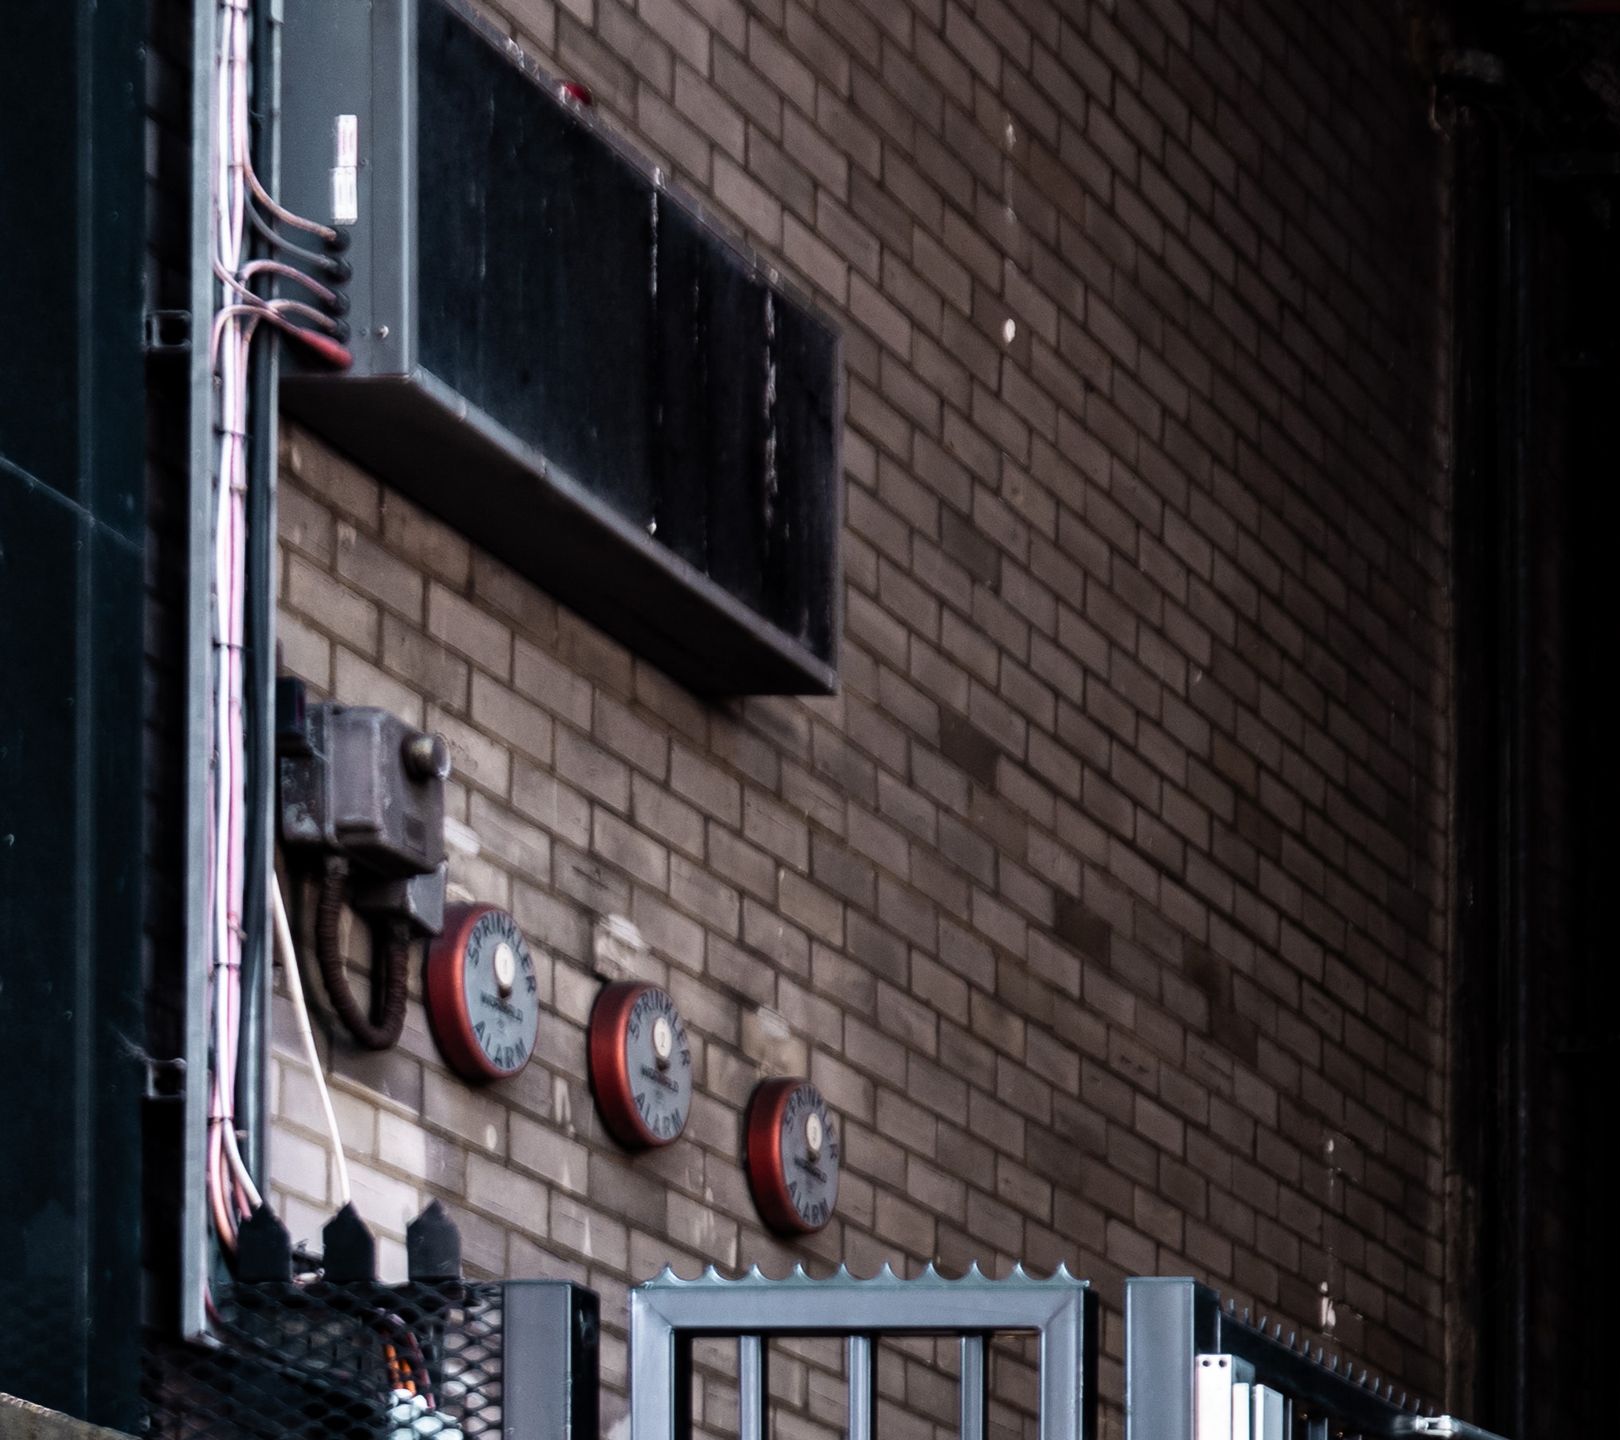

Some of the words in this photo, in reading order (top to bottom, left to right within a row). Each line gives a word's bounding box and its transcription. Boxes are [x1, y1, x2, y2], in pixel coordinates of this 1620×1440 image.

[469, 911, 536, 993] SPRINKLER
[473, 1021, 528, 1068] ALARM
[635, 1092, 683, 1136] ALARM
[789, 1182, 831, 1225] ALARM
